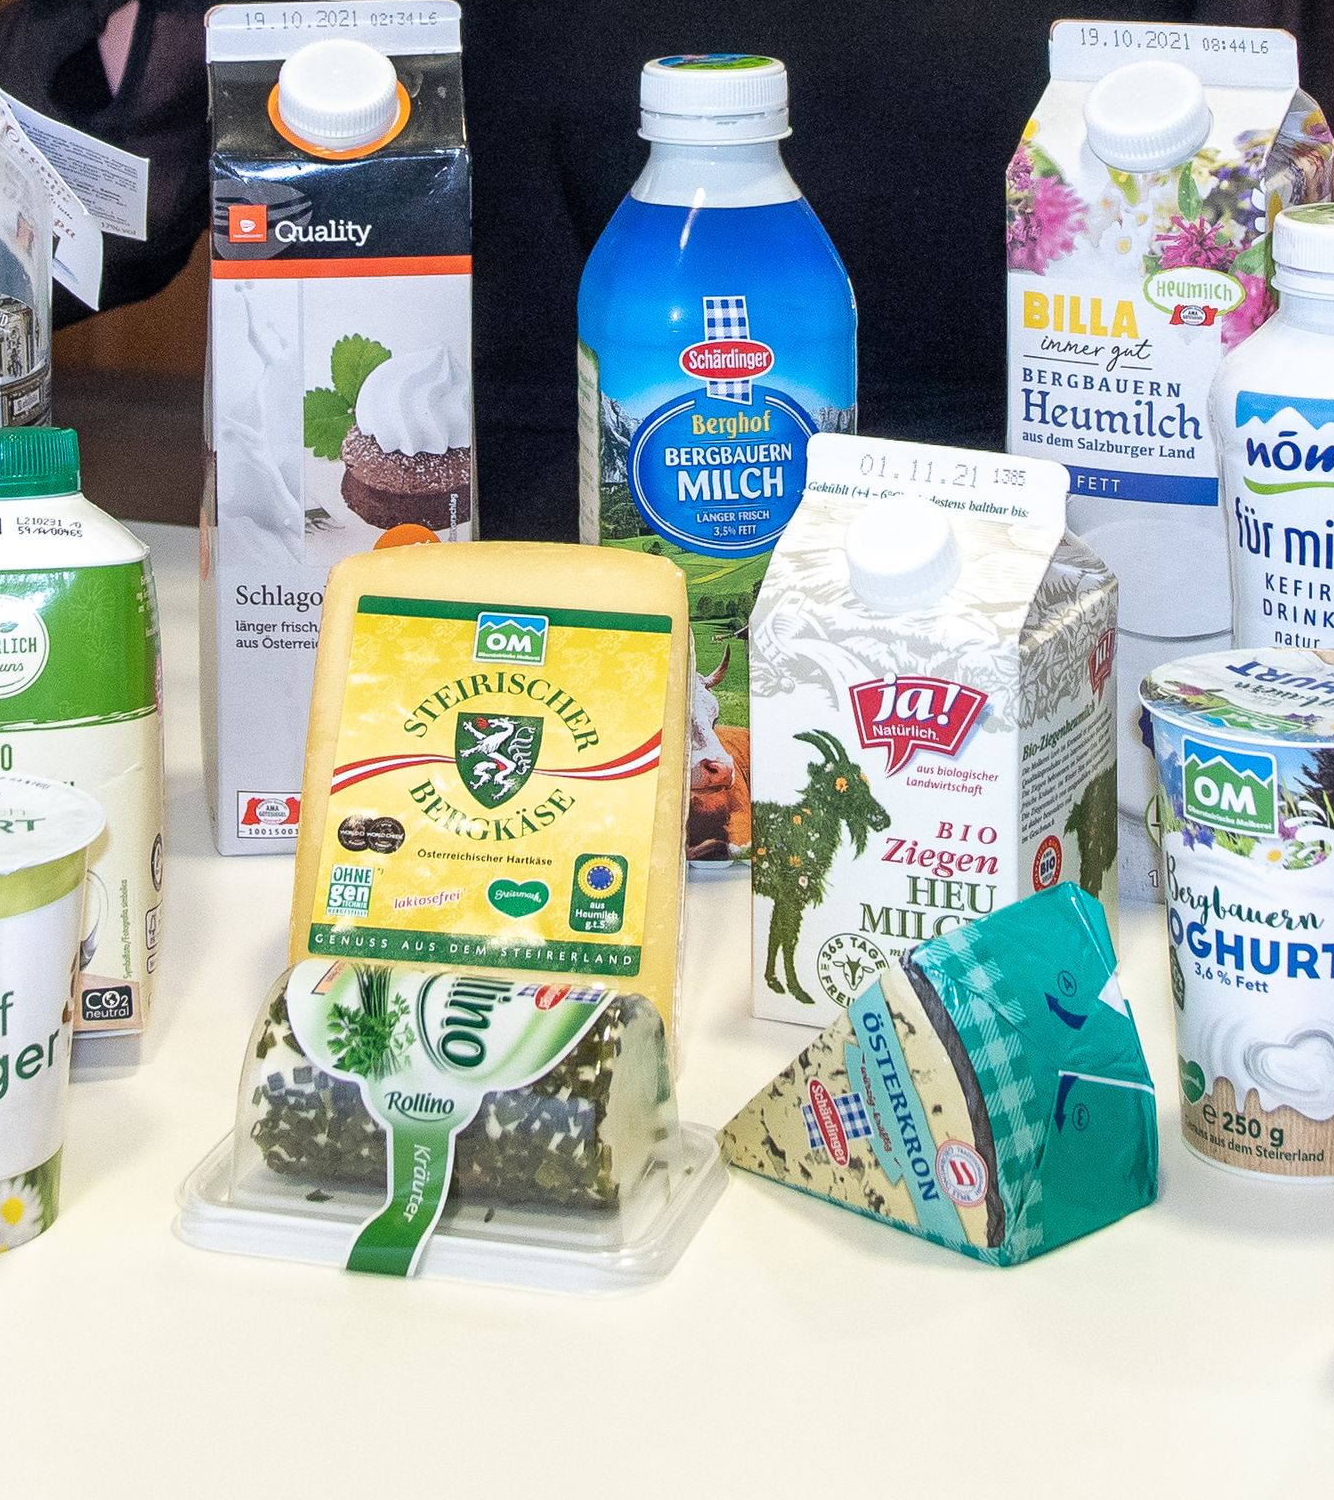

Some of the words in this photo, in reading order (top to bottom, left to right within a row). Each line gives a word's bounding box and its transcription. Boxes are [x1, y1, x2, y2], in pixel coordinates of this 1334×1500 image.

[245, 10, 357, 30] 19.10.2021
[1081, 28, 1190, 50] 19.10.2021
[275, 220, 371, 246] Quality
[1156, 280, 1232, 302] Heumilch
[1023, 291, 1139, 340] BILLA
[688, 350, 769, 370] Schärdinger
[1041, 336, 1105, 356] immer
[1106, 338, 1153, 372] gut
[1022, 368, 1182, 398] BERGBAUERN
[692, 410, 771, 439] Berghof
[1021, 388, 1203, 441] Heumilch
[665, 443, 792, 466] BERGBAUERN
[1022, 431, 1043, 443] aus
[1047, 433, 1073, 448] dem
[1078, 437, 1155, 458] Salzburger
[1159, 447, 1195, 459] Land
[859, 453, 978, 489] 01.11.21
[1077, 475, 1120, 492] FETT
[677, 467, 783, 502] MILCH
[807, 480, 849, 496] Gekühlt
[697, 510, 736, 523] LÄNGER
[739, 510, 769, 521] FRISCH
[968, 500, 1008, 515] haltbar
[1011, 506, 1029, 518] bis:
[713, 525, 736, 537] 3,5%
[739, 525, 756, 535] FETT
[1235, 497, 1273, 558] für
[1265, 572, 1331, 601] KEFIR
[1263, 598, 1334, 628] DRINK
[236, 620, 277, 634] länger
[1275, 630, 1320, 648] natur
[236, 638, 258, 649] aus
[485, 632, 532, 653] OM
[0, 661, 24, 673] uns
[403, 671, 599, 753] STEIRISCHER
[875, 672, 961, 726] ja!
[872, 723, 939, 742] Natürlich.
[906, 777, 983, 796] Landwirtschaft
[917, 765, 935, 776] aus
[937, 765, 998, 782] biologischer
[1194, 776, 1257, 816] OM
[408, 778, 576, 842] BERGKÄSE
[936, 820, 998, 845] BIO
[417, 849, 503, 863] Österreichischer
[507, 854, 552, 866] Hartkäse
[881, 837, 999, 878] Ziegen
[334, 867, 371, 884] OHNE
[329, 885, 369, 907] gen
[394, 889, 461, 909] laktosefrei
[589, 901, 606, 910] aus
[906, 874, 997, 914] HEU
[1167, 855, 1324, 930] Bergbauern
[575, 909, 618, 921] Heumilch
[314, 933, 389, 950] GENUSS
[402, 940, 436, 952] AUS
[450, 943, 488, 957] DEM
[501, 946, 634, 966] STEIRERLAND
[822, 937, 844, 962] 365
[849, 937, 885, 970] TAGE
[1195, 962, 1213, 980] 3,6
[1217, 970, 1231, 985] %
[1236, 976, 1269, 993] Fett
[86, 1005, 129, 1019] neutral
[385, 1090, 455, 1116] Rollino
[862, 1011, 940, 1201] ÖSTERKRON
[810, 1084, 845, 1164] Schärdinger
[1223, 1111, 1261, 1138] 250
[1270, 1126, 1284, 1147] g
[1210, 1132, 1225, 1145] aus
[1228, 1139, 1252, 1156] dem
[1256, 1144, 1324, 1162] Steirerland
[402, 1144, 431, 1224] Kräuter
